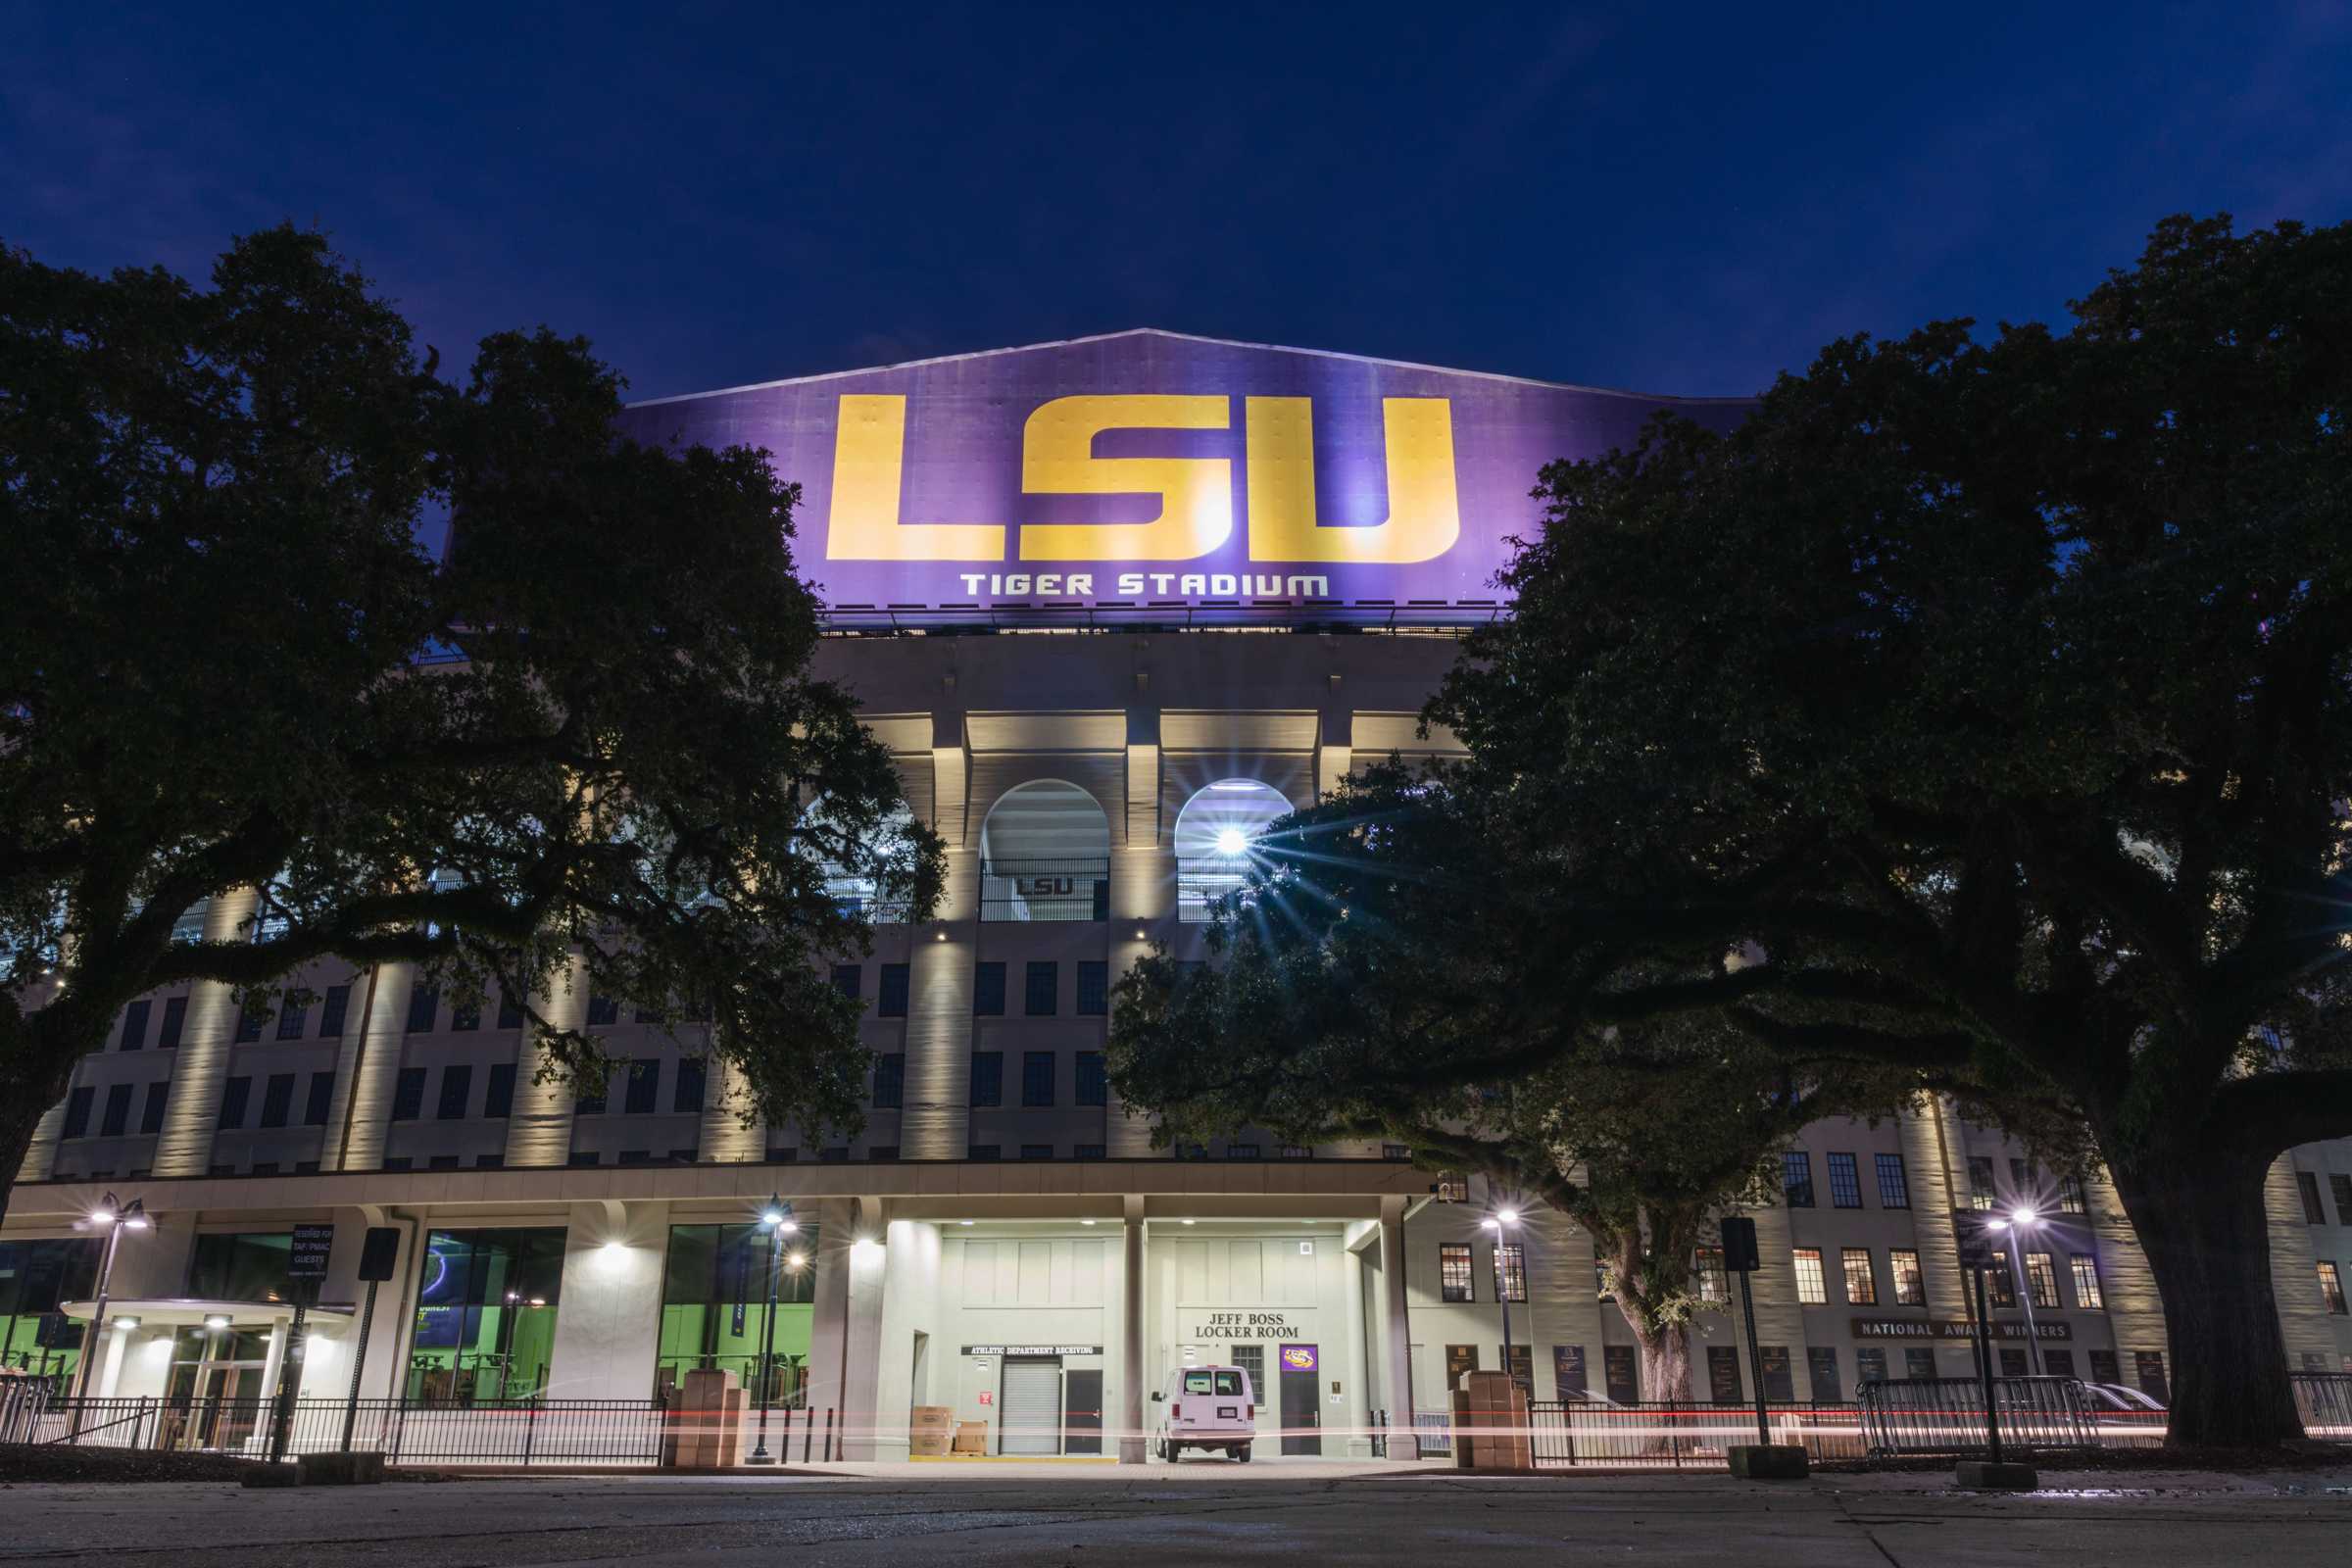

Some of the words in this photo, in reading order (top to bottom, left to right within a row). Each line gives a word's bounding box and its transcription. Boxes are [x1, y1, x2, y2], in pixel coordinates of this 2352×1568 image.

[826, 394, 1459, 564] LSU
[959, 573, 1094, 596] TIGER
[1118, 573, 1328, 597] STADIUM
[1016, 877, 1073, 896] LSU
[1209, 1313, 1243, 1325] JEFF
[1249, 1313, 1284, 1325] BOSS
[1196, 1326, 1252, 1339] LOCKER
[1257, 1326, 1298, 1339] ROOM
[1861, 1323, 1935, 1336] NATIONAL
[1006, 1347, 1054, 1355] DEPARTMENT
[1055, 1347, 1094, 1355] RECEIVING
